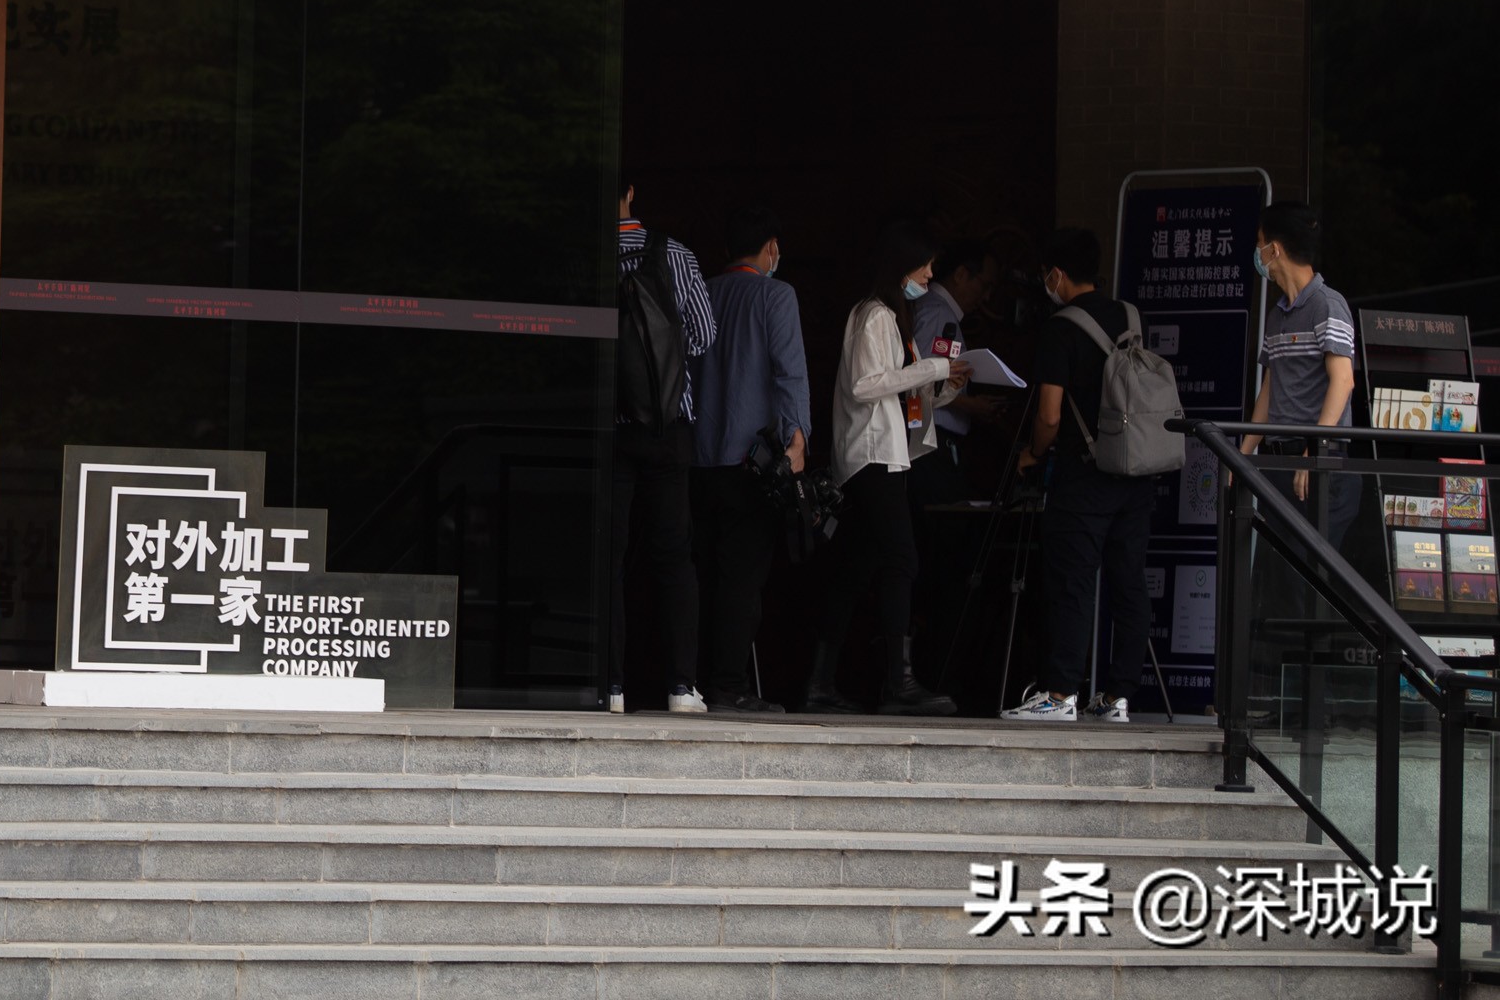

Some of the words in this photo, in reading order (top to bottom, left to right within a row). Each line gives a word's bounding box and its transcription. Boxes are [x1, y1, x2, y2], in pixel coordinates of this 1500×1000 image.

[1151, 228, 1234, 259] 温馨提示
[1375, 317, 1456, 335] 太平手袋厂陈列馆
[124, 518, 311, 573] 对外加工
[123, 571, 262, 627] 第一家
[264, 593, 304, 614] THE
[307, 595, 365, 615] FIRST
[263, 615, 451, 638] EXPORT-ORIENTED
[263, 636, 392, 659] PROCESSING
[262, 658, 359, 678] COMPANY
